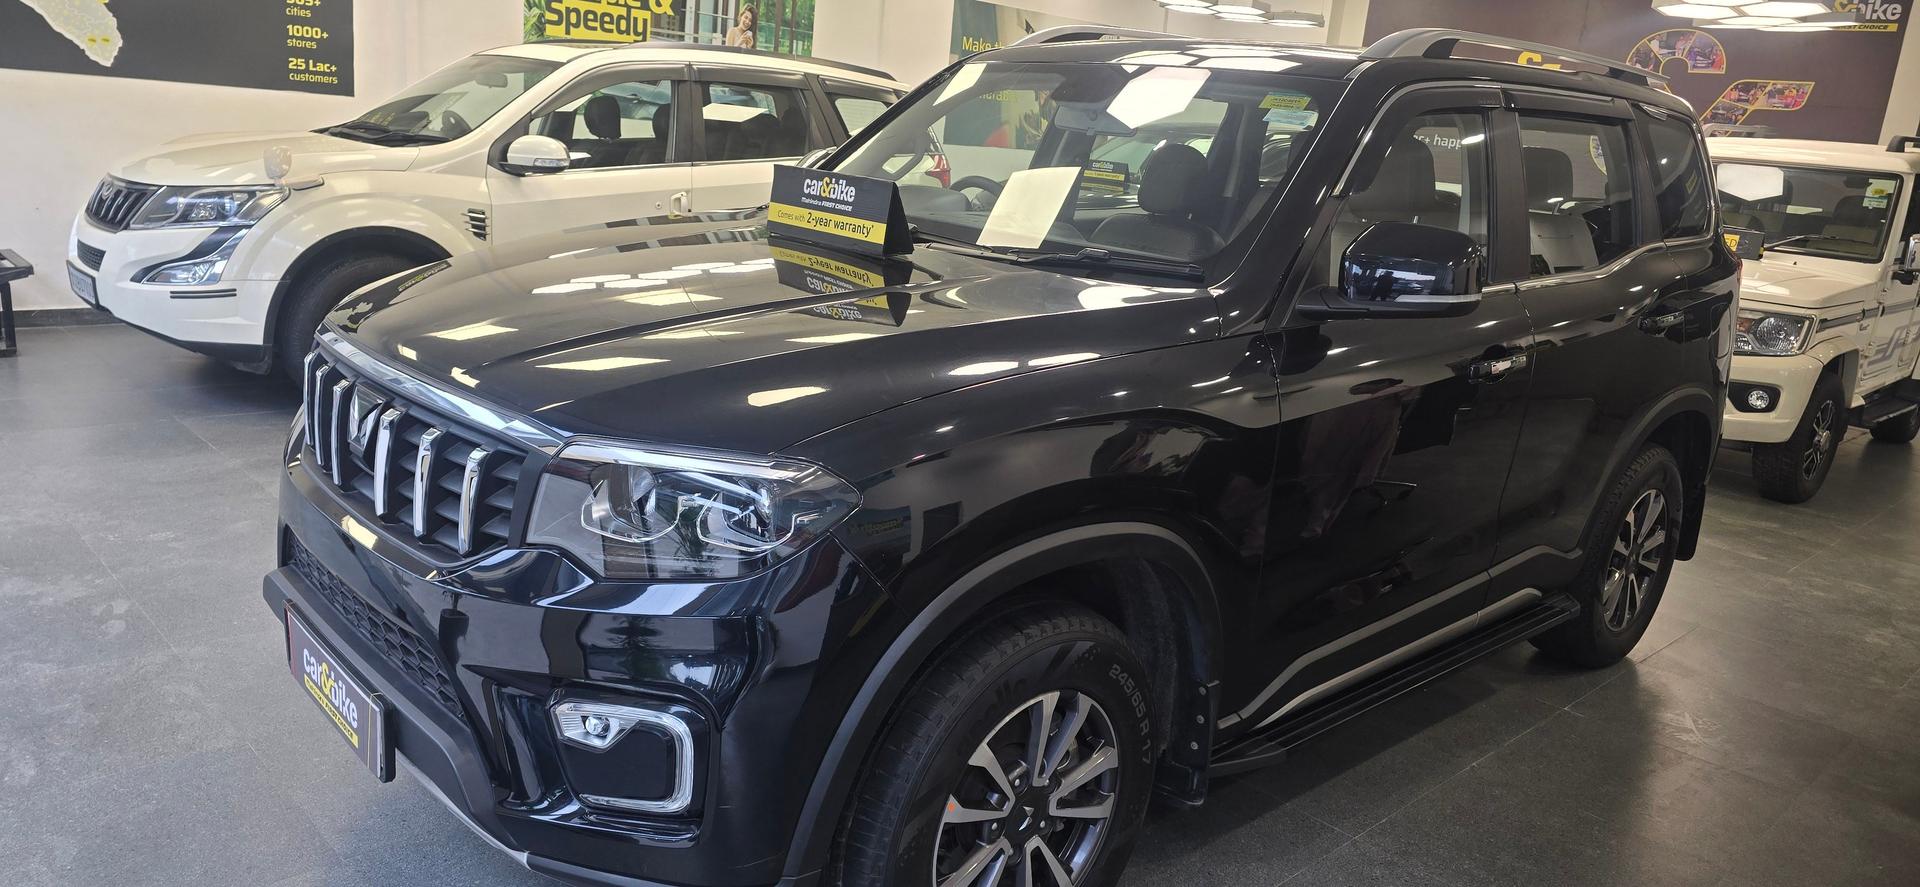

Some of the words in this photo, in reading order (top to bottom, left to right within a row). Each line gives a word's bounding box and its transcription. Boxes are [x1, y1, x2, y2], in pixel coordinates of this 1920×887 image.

[286, 6, 312, 17] cities
[546, 0, 648, 42] Speedy
[286, 25, 329, 39] 1000+
[286, 39, 317, 49] stores
[962, 36, 992, 52] Make
[288, 58, 306, 70] 25
[308, 60, 337, 72] Lac+
[289, 73, 338, 84] customers
[803, 176, 856, 202] car&bike
[807, 212, 832, 228] 2-year
[303, 648, 358, 729] car&bike
[1109, 663, 1147, 718] 245/65
[1140, 718, 1150, 736] R
